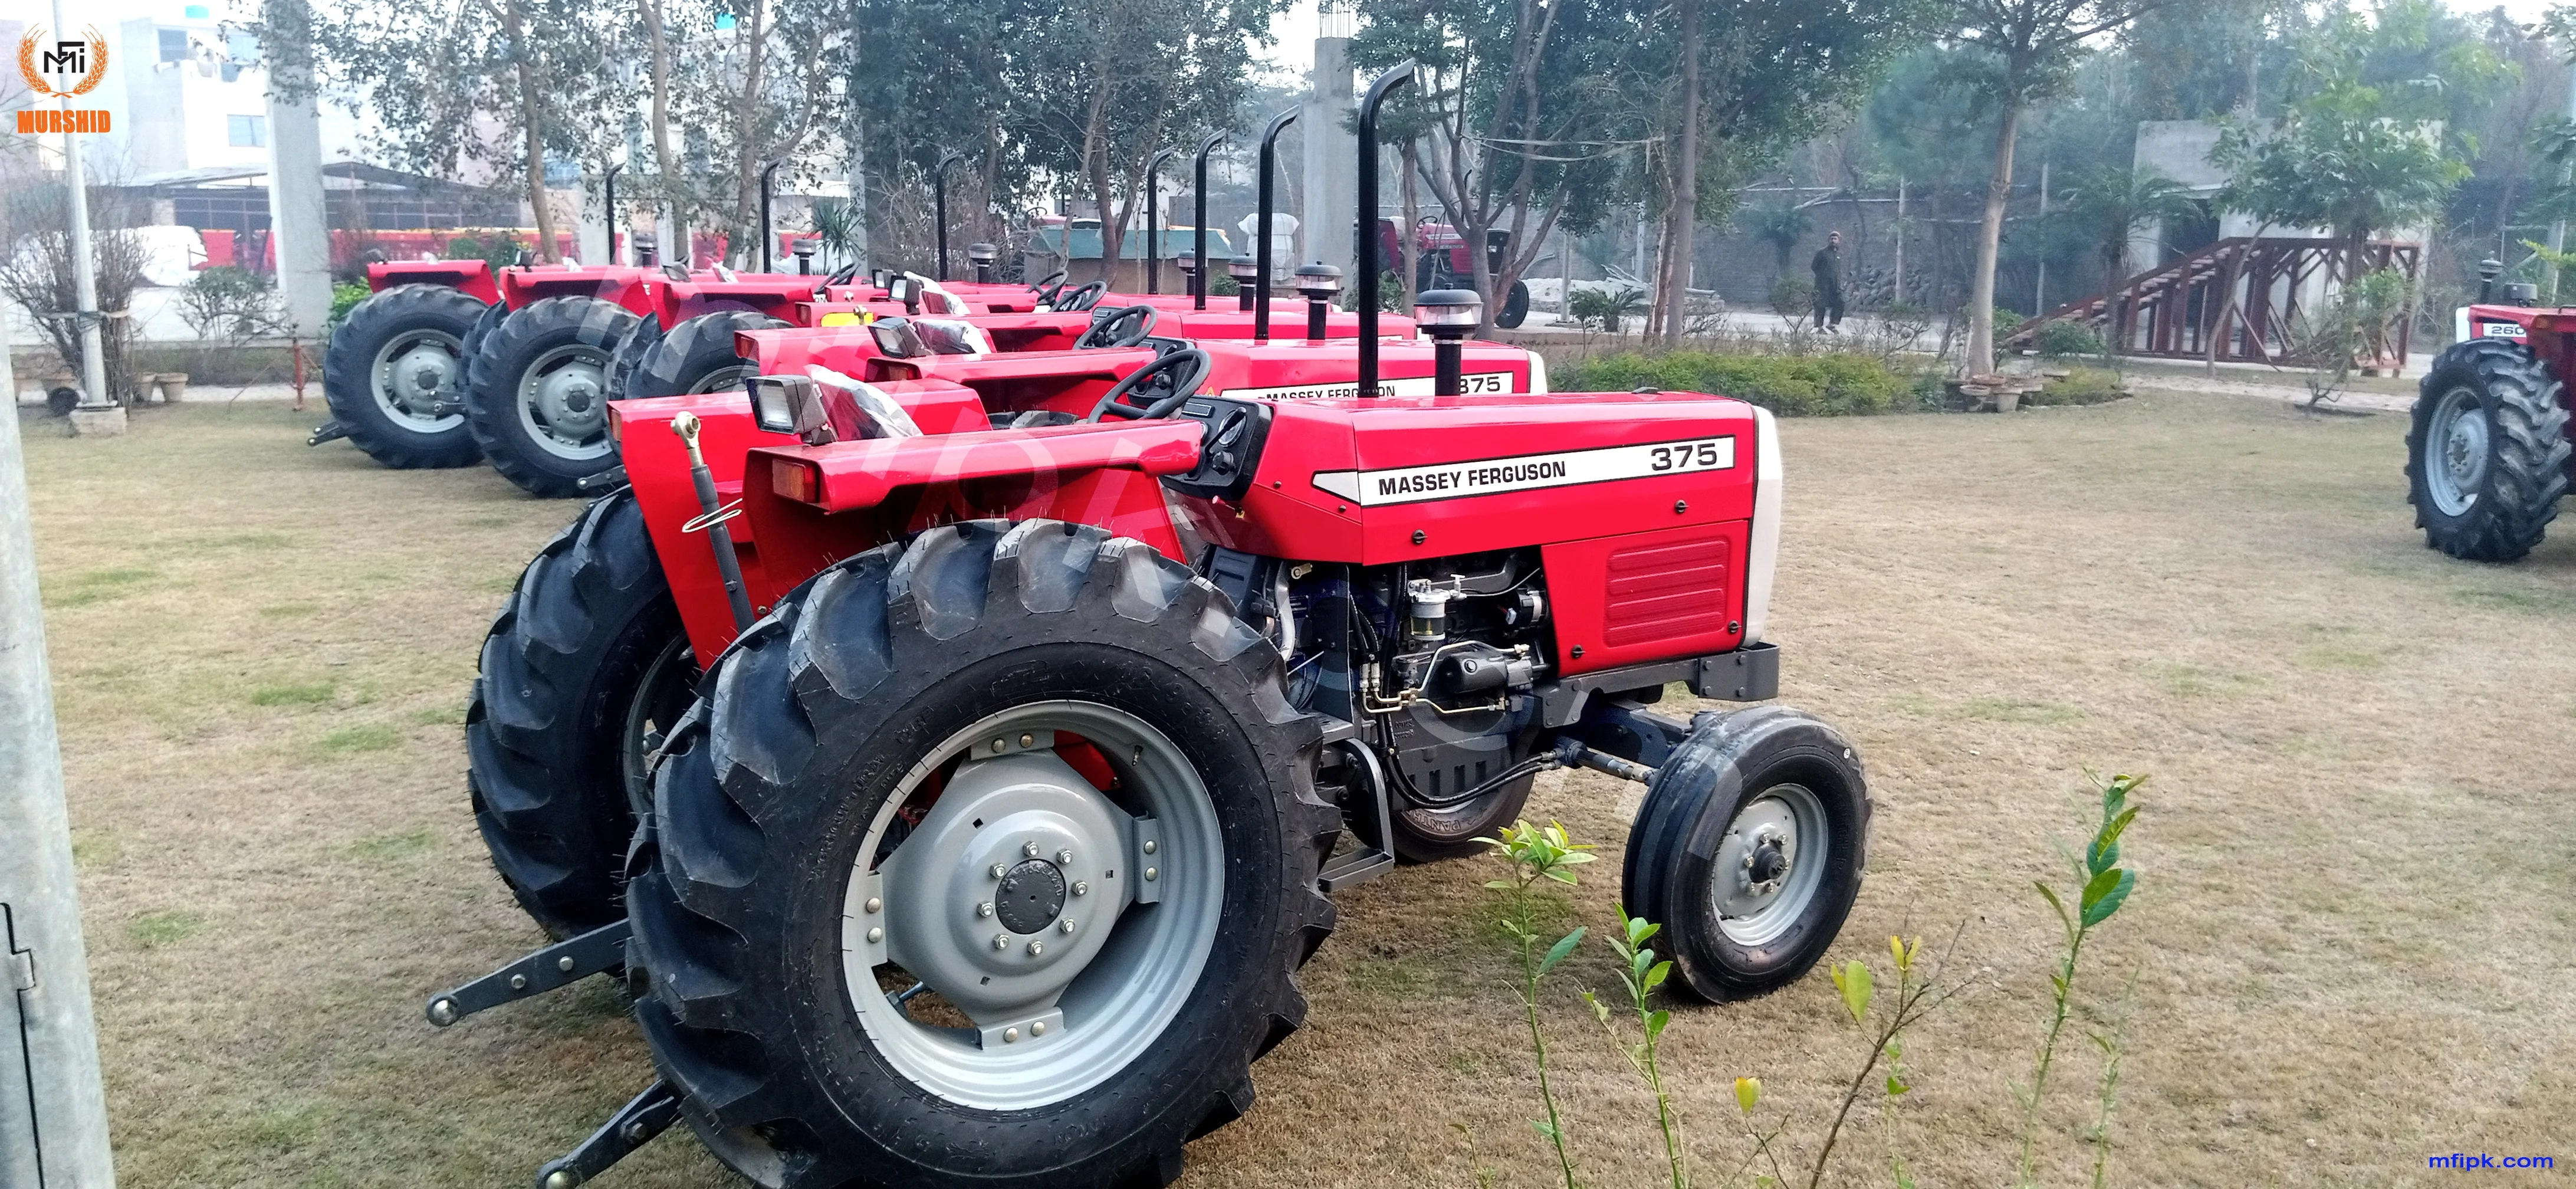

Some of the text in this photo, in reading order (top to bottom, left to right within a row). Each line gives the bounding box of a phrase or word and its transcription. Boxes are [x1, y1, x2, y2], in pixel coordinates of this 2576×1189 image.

[2492, 326, 2526, 335] 260
[1328, 386, 1395, 398] FERGON
[1379, 443, 1717, 495] MASSEY FERGUSON 375
